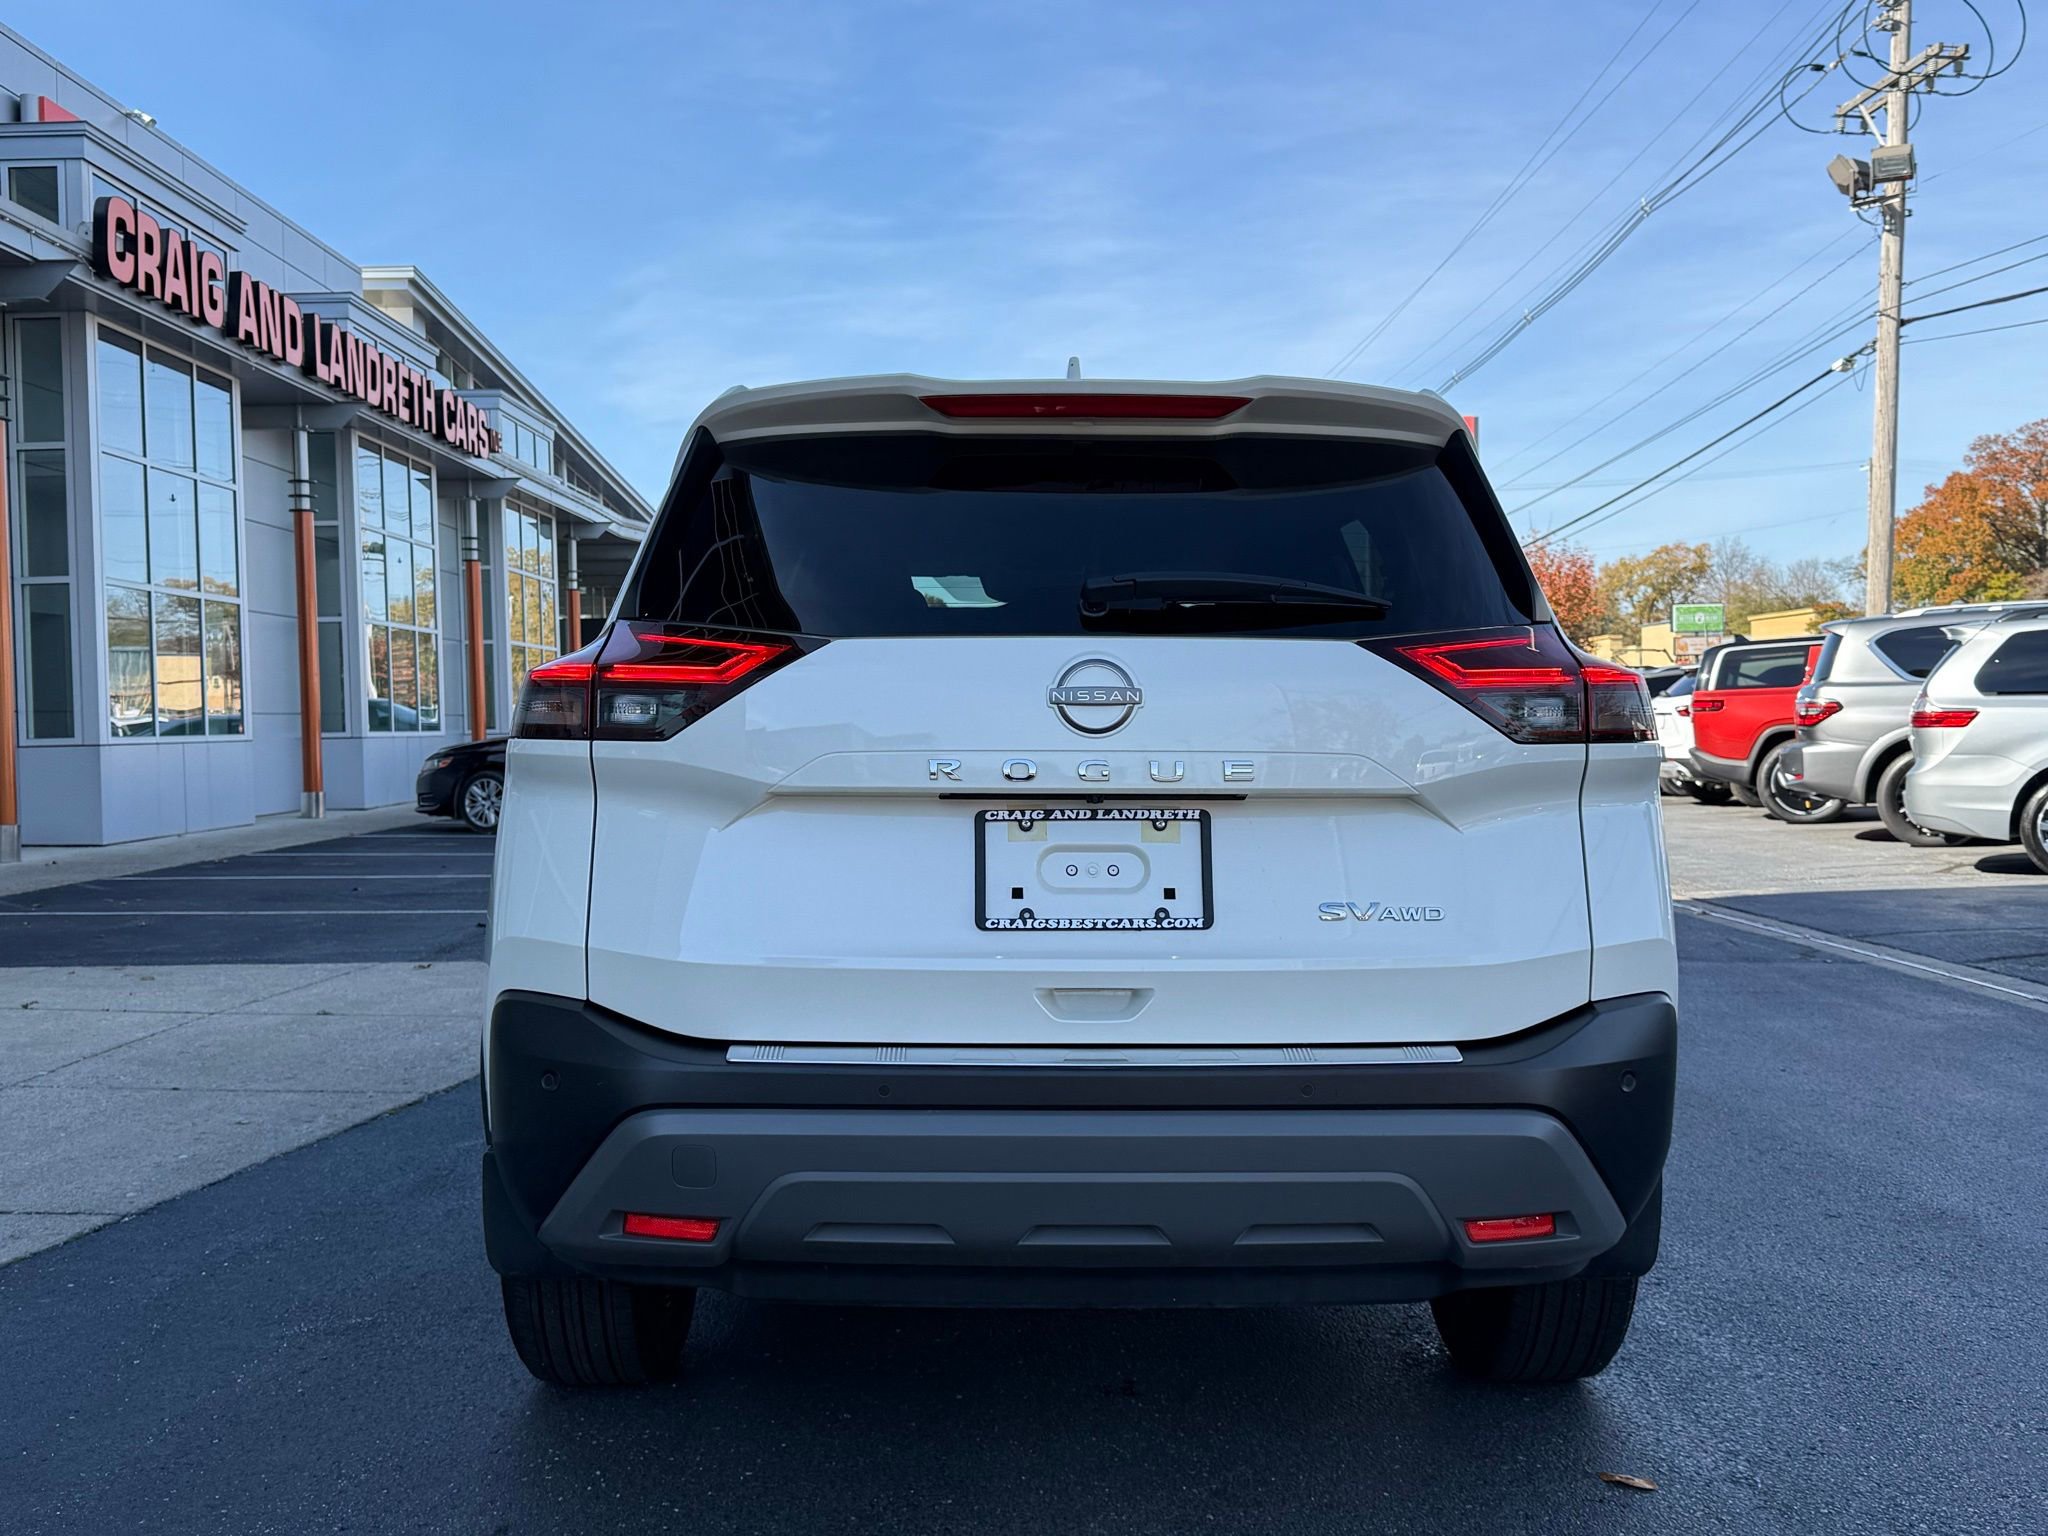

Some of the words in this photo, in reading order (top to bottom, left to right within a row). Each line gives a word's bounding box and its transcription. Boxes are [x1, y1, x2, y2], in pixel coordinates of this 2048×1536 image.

[94, 196, 225, 329] CRAIG
[228, 271, 302, 368] AND
[304, 313, 437, 435] LANDRETH
[436, 389, 490, 459] CARS
[1052, 690, 1141, 703] NISSAN
[928, 758, 1255, 783] ROGUE
[985, 810, 1045, 820] CRAIG
[1050, 810, 1092, 819] AND
[1096, 810, 1201, 819] LANDRETH
[1319, 902, 1380, 921] SV
[1379, 906, 1445, 921] AWD
[985, 919, 1205, 929] CRAIGSBESTCARS.COM
